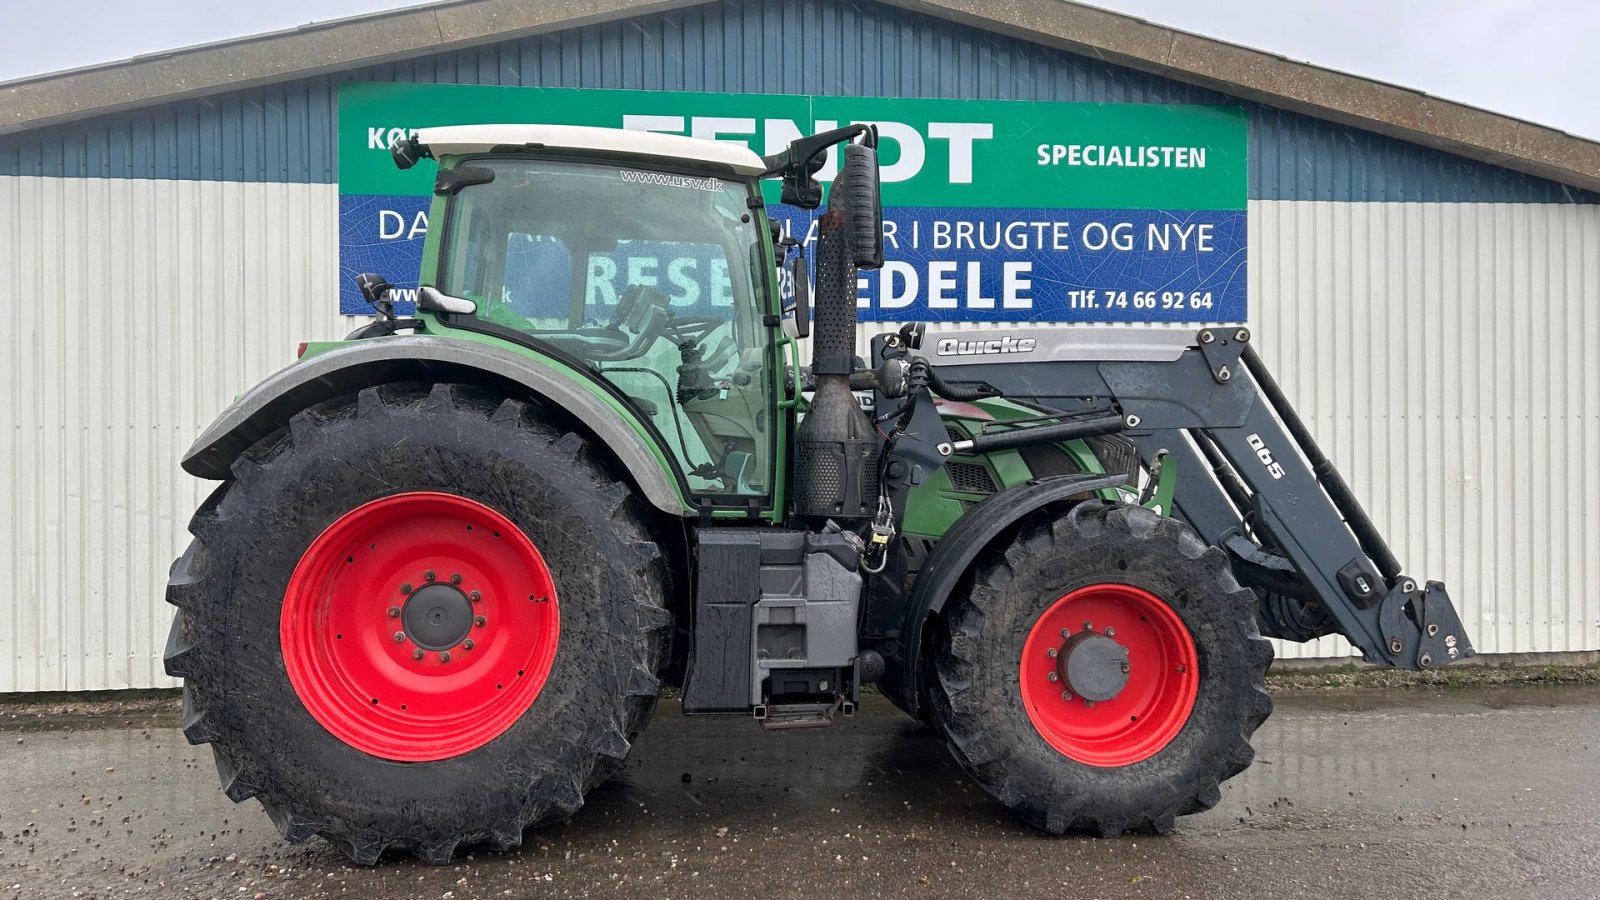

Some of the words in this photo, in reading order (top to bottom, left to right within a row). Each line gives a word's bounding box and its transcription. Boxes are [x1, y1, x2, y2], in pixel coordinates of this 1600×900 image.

[1037, 144, 1206, 168] SPECIALISTEN
[620, 170, 723, 192] www.usv.dk
[934, 222, 1069, 250] BRUGTE
[1082, 222, 1133, 250] OG
[1148, 224, 1214, 252] NYE
[1068, 290, 1099, 308] Tlf.
[1105, 291, 1127, 308] 74
[1133, 291, 1156, 308] 66
[1161, 291, 1184, 309] 92
[1190, 291, 1212, 309] 64
[937, 336, 1036, 356] Quicke
[1246, 433, 1286, 479] Q65
